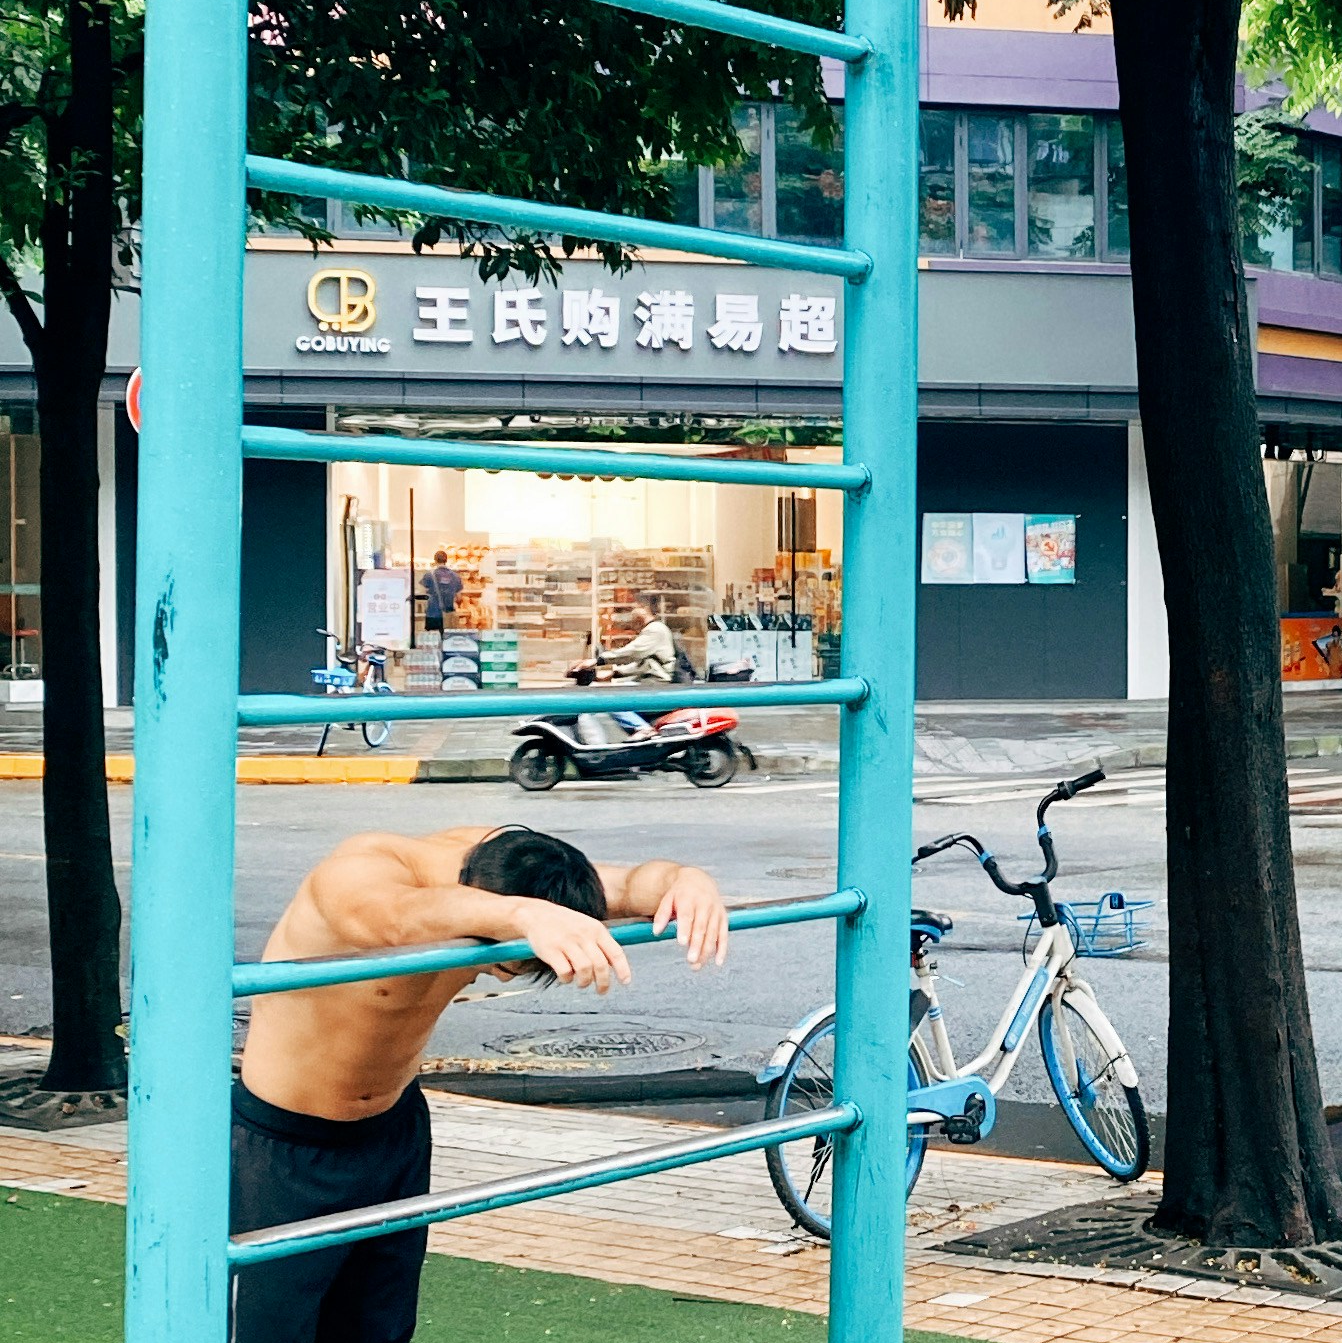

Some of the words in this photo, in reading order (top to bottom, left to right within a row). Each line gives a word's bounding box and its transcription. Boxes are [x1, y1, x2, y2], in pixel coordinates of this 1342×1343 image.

[411, 285, 840, 354] 王氏购满易超
[295, 335, 392, 353] GOBUYING
